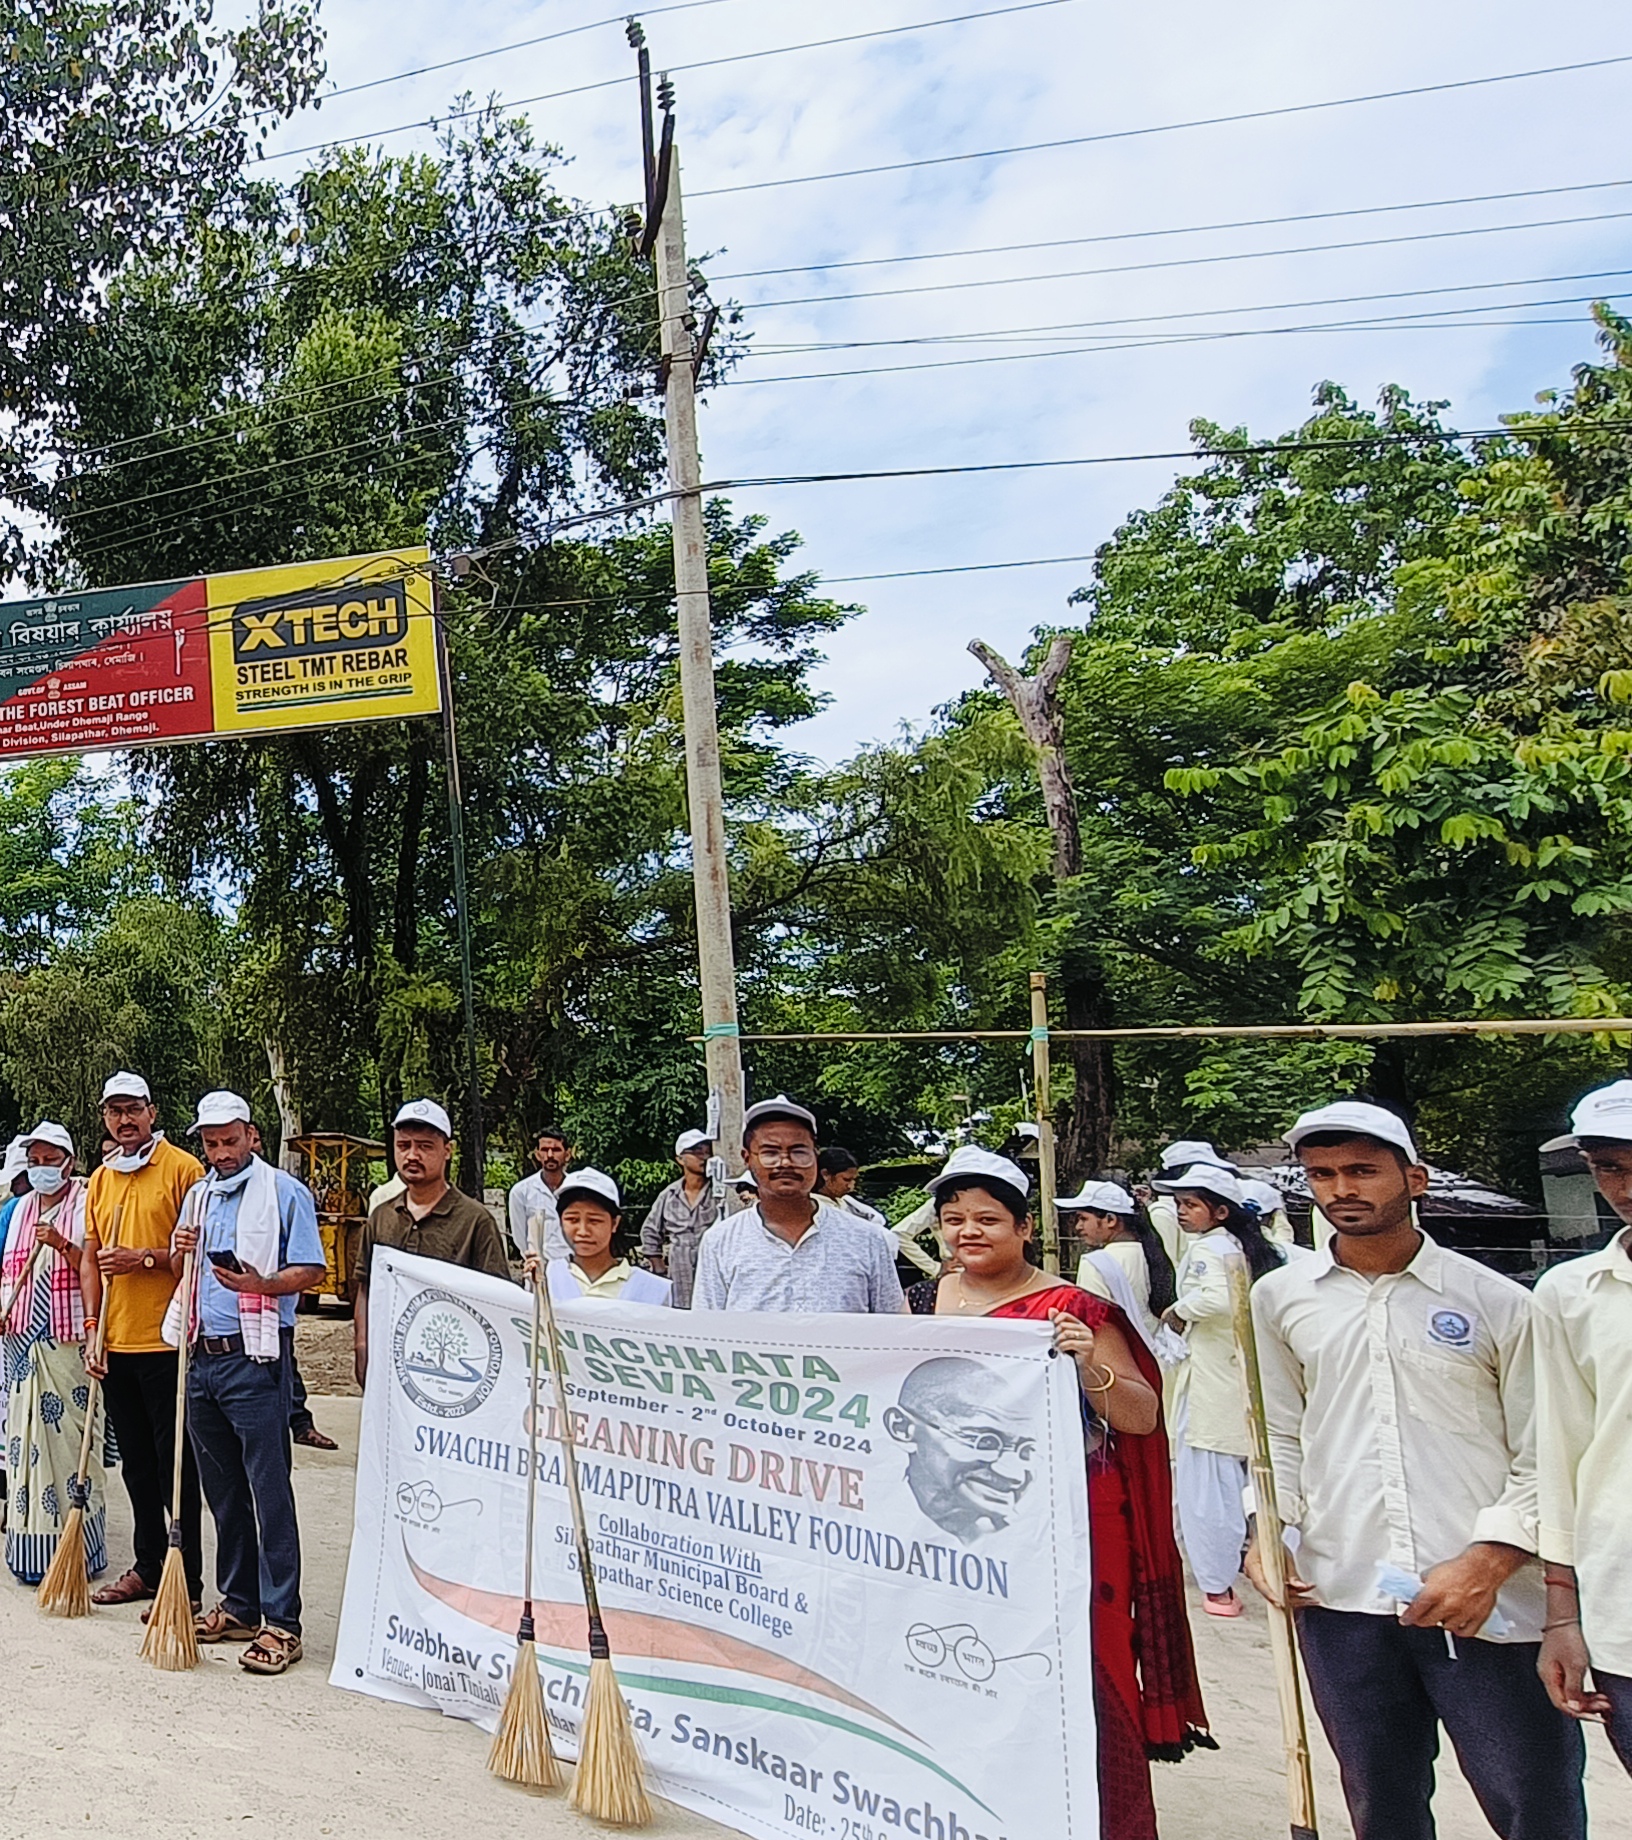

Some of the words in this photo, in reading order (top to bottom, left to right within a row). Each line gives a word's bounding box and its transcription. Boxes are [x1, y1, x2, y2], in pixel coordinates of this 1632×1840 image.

[238, 597, 398, 652] XTECH
[235, 684, 309, 701] STRENGTH
[312, 681, 325, 692] IS
[329, 679, 343, 690] IN
[348, 675, 374, 688] THE
[378, 672, 412, 685] GRIP
[237, 664, 295, 685] STEEL
[299, 655, 336, 676] TMT
[342, 648, 409, 673] REBAR
[29, 698, 85, 719] FOREST
[88, 693, 125, 712] BEAT
[129, 686, 194, 707] OFFICER
[72, 713, 114, 729] Dhemaji
[115, 709, 149, 724] Range
[2, 735, 49, 749] Division,
[563, 1382, 669, 1415] September
[691, 1405, 718, 1422] 2nd
[723, 1413, 807, 1443] October
[813, 1429, 873, 1455] 2024
[584, 1356, 716, 1402] SEVA
[731, 1378, 871, 1430] 2024
[522, 1403, 715, 1477] CLEANING
[727, 1442, 864, 1511] DRIVE
[414, 1425, 511, 1475] SWACHH
[706, 1491, 801, 1546] VALLEY
[809, 1514, 1009, 1600] FOUNDATION
[554, 1525, 640, 1564] Silpathar
[643, 1549, 730, 1591] Municipal
[735, 1572, 789, 1608] Board
[794, 1592, 810, 1614] &
[598, 1513, 715, 1561] Collaboration
[719, 1543, 762, 1574] With
[657, 1578, 724, 1614] Science
[728, 1598, 793, 1638] College
[386, 1614, 482, 1672] Swabhav
[670, 1713, 823, 1794] Sanskaar
[422, 1664, 456, 1693] Jonai
